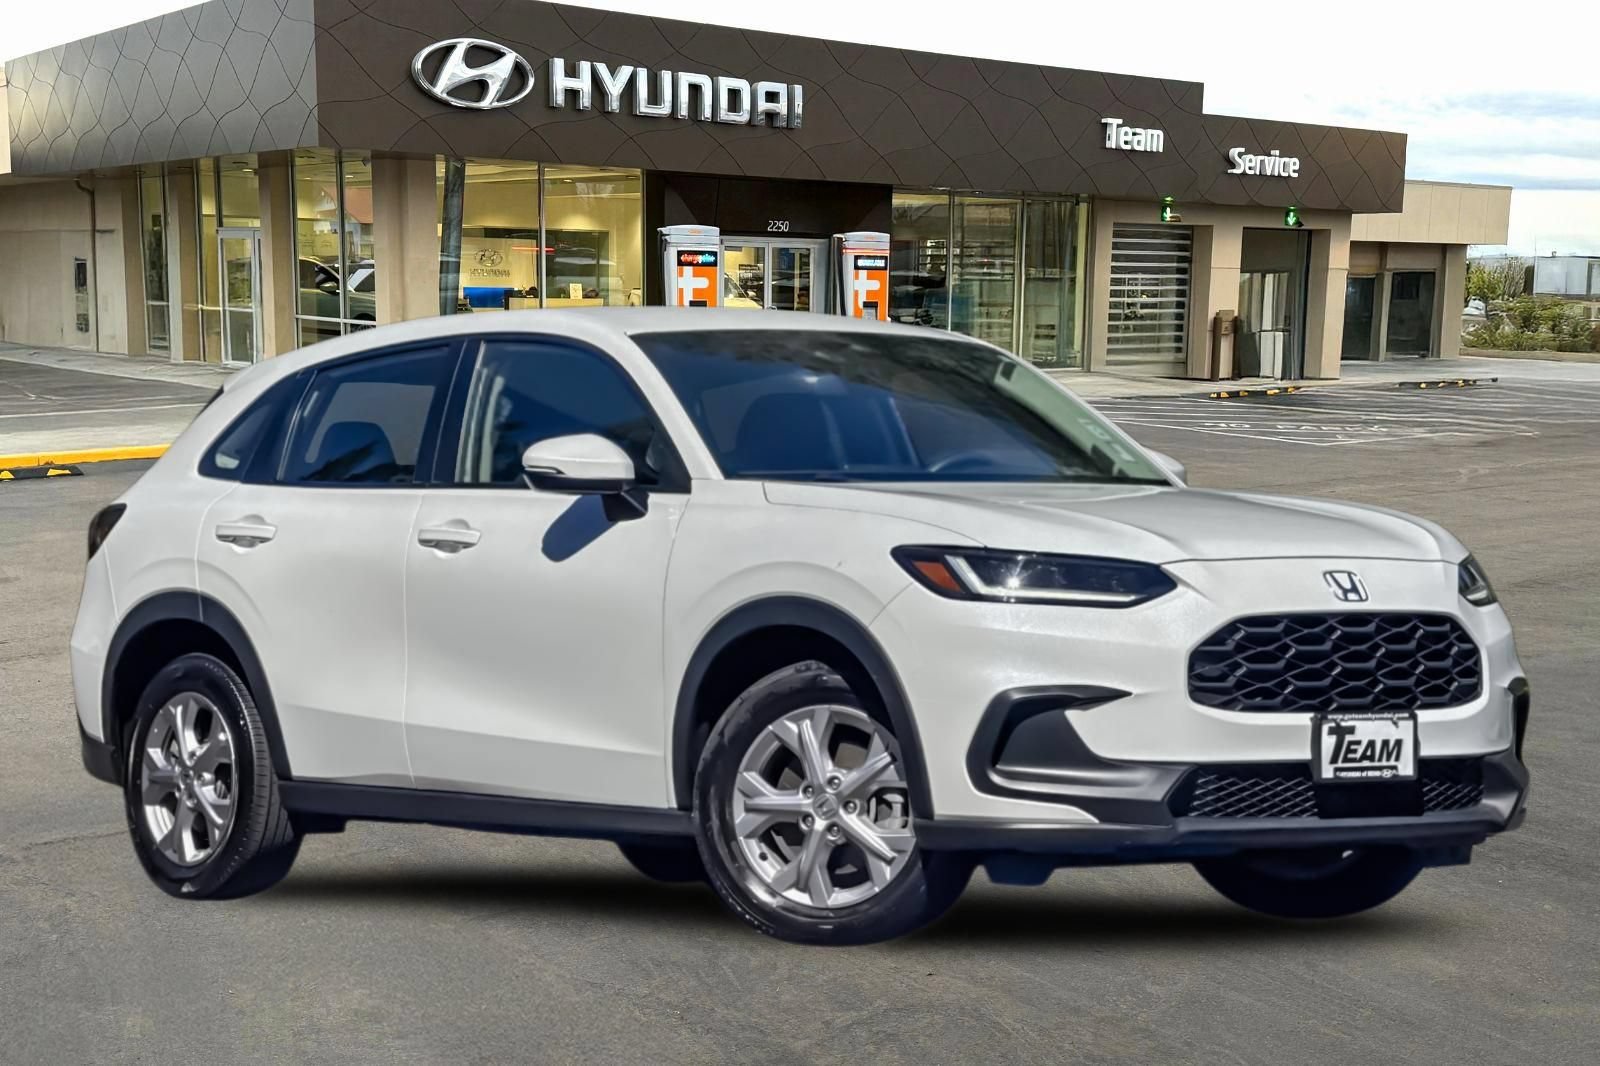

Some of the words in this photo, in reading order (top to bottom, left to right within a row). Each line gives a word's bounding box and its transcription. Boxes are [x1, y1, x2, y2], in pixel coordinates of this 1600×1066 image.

[549, 57, 803, 129] HYUNDAI
[1101, 117, 1164, 152] Team
[1227, 147, 1300, 177] Service
[767, 220, 790, 232] 2250
[1327, 724, 1403, 765] TEAM
